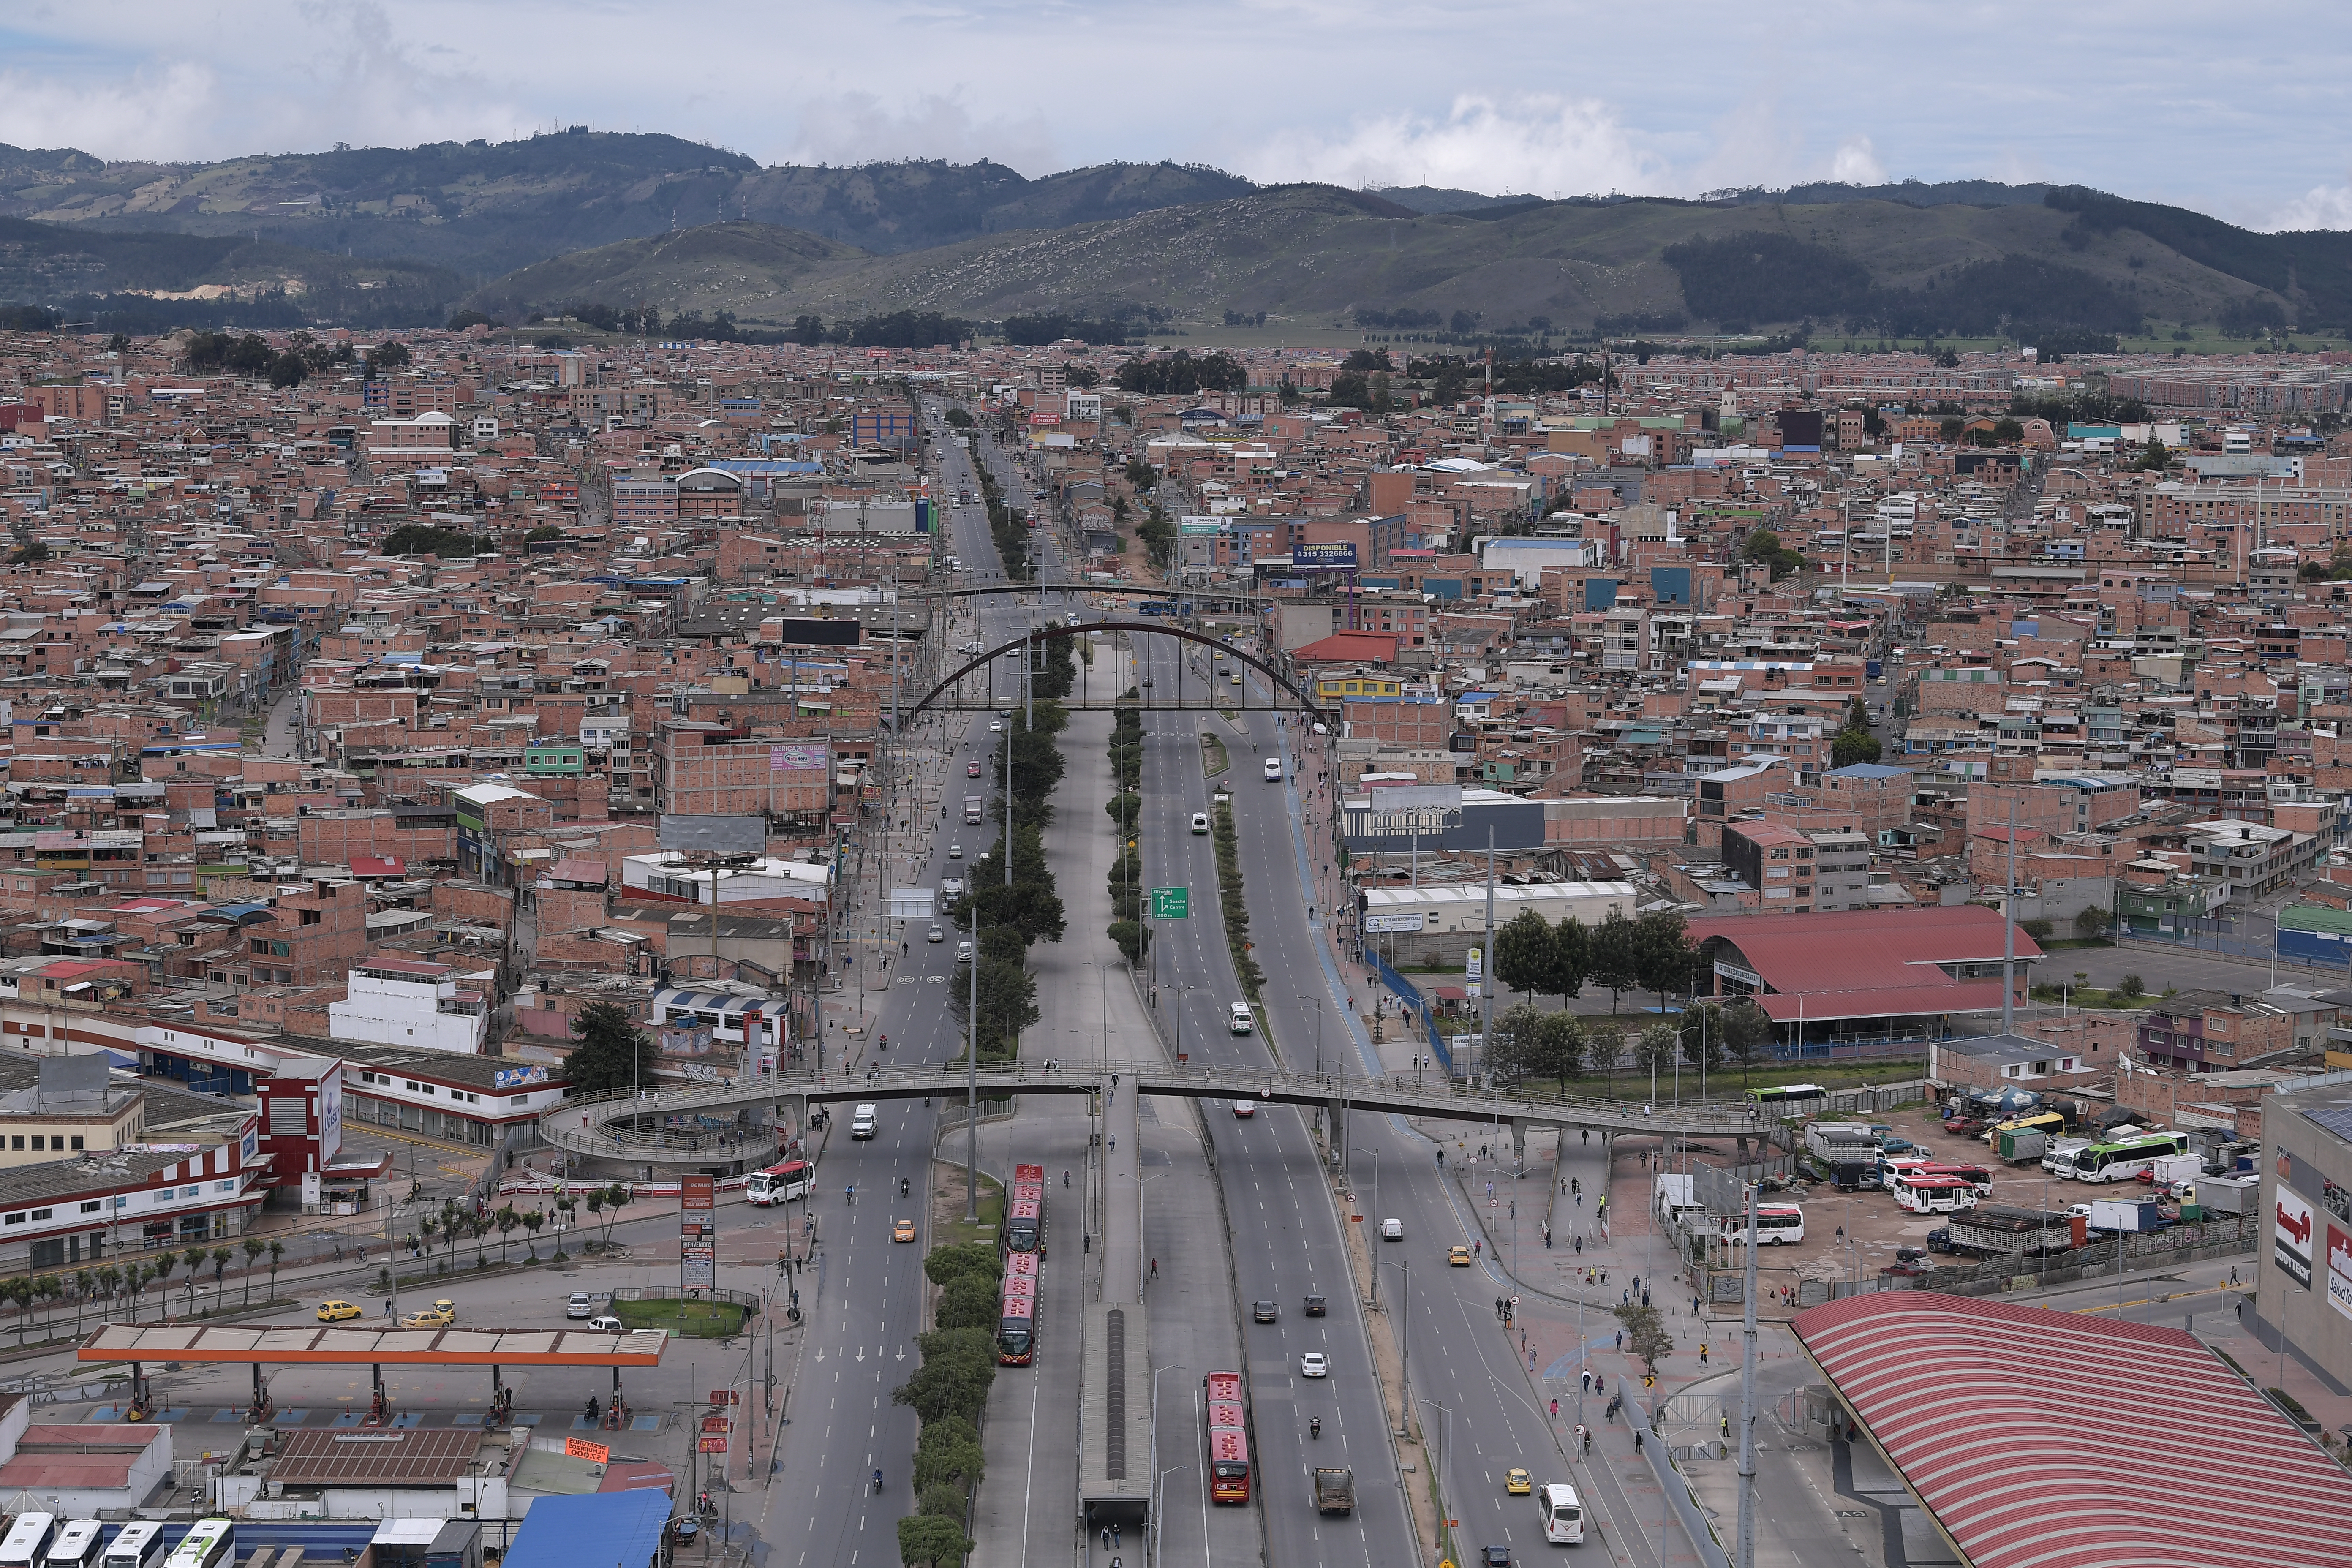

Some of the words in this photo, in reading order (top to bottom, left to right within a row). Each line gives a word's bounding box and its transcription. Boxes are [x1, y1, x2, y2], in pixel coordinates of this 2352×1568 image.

[1719, 964, 1731, 974] REVISIÓN
[1731, 968, 1742, 977] TÉCNICO
[1742, 971, 1756, 981] MECÁNICA
[324, 1112, 340, 1132] Unisur
[2275, 1247, 2308, 1281] BODYTECH
